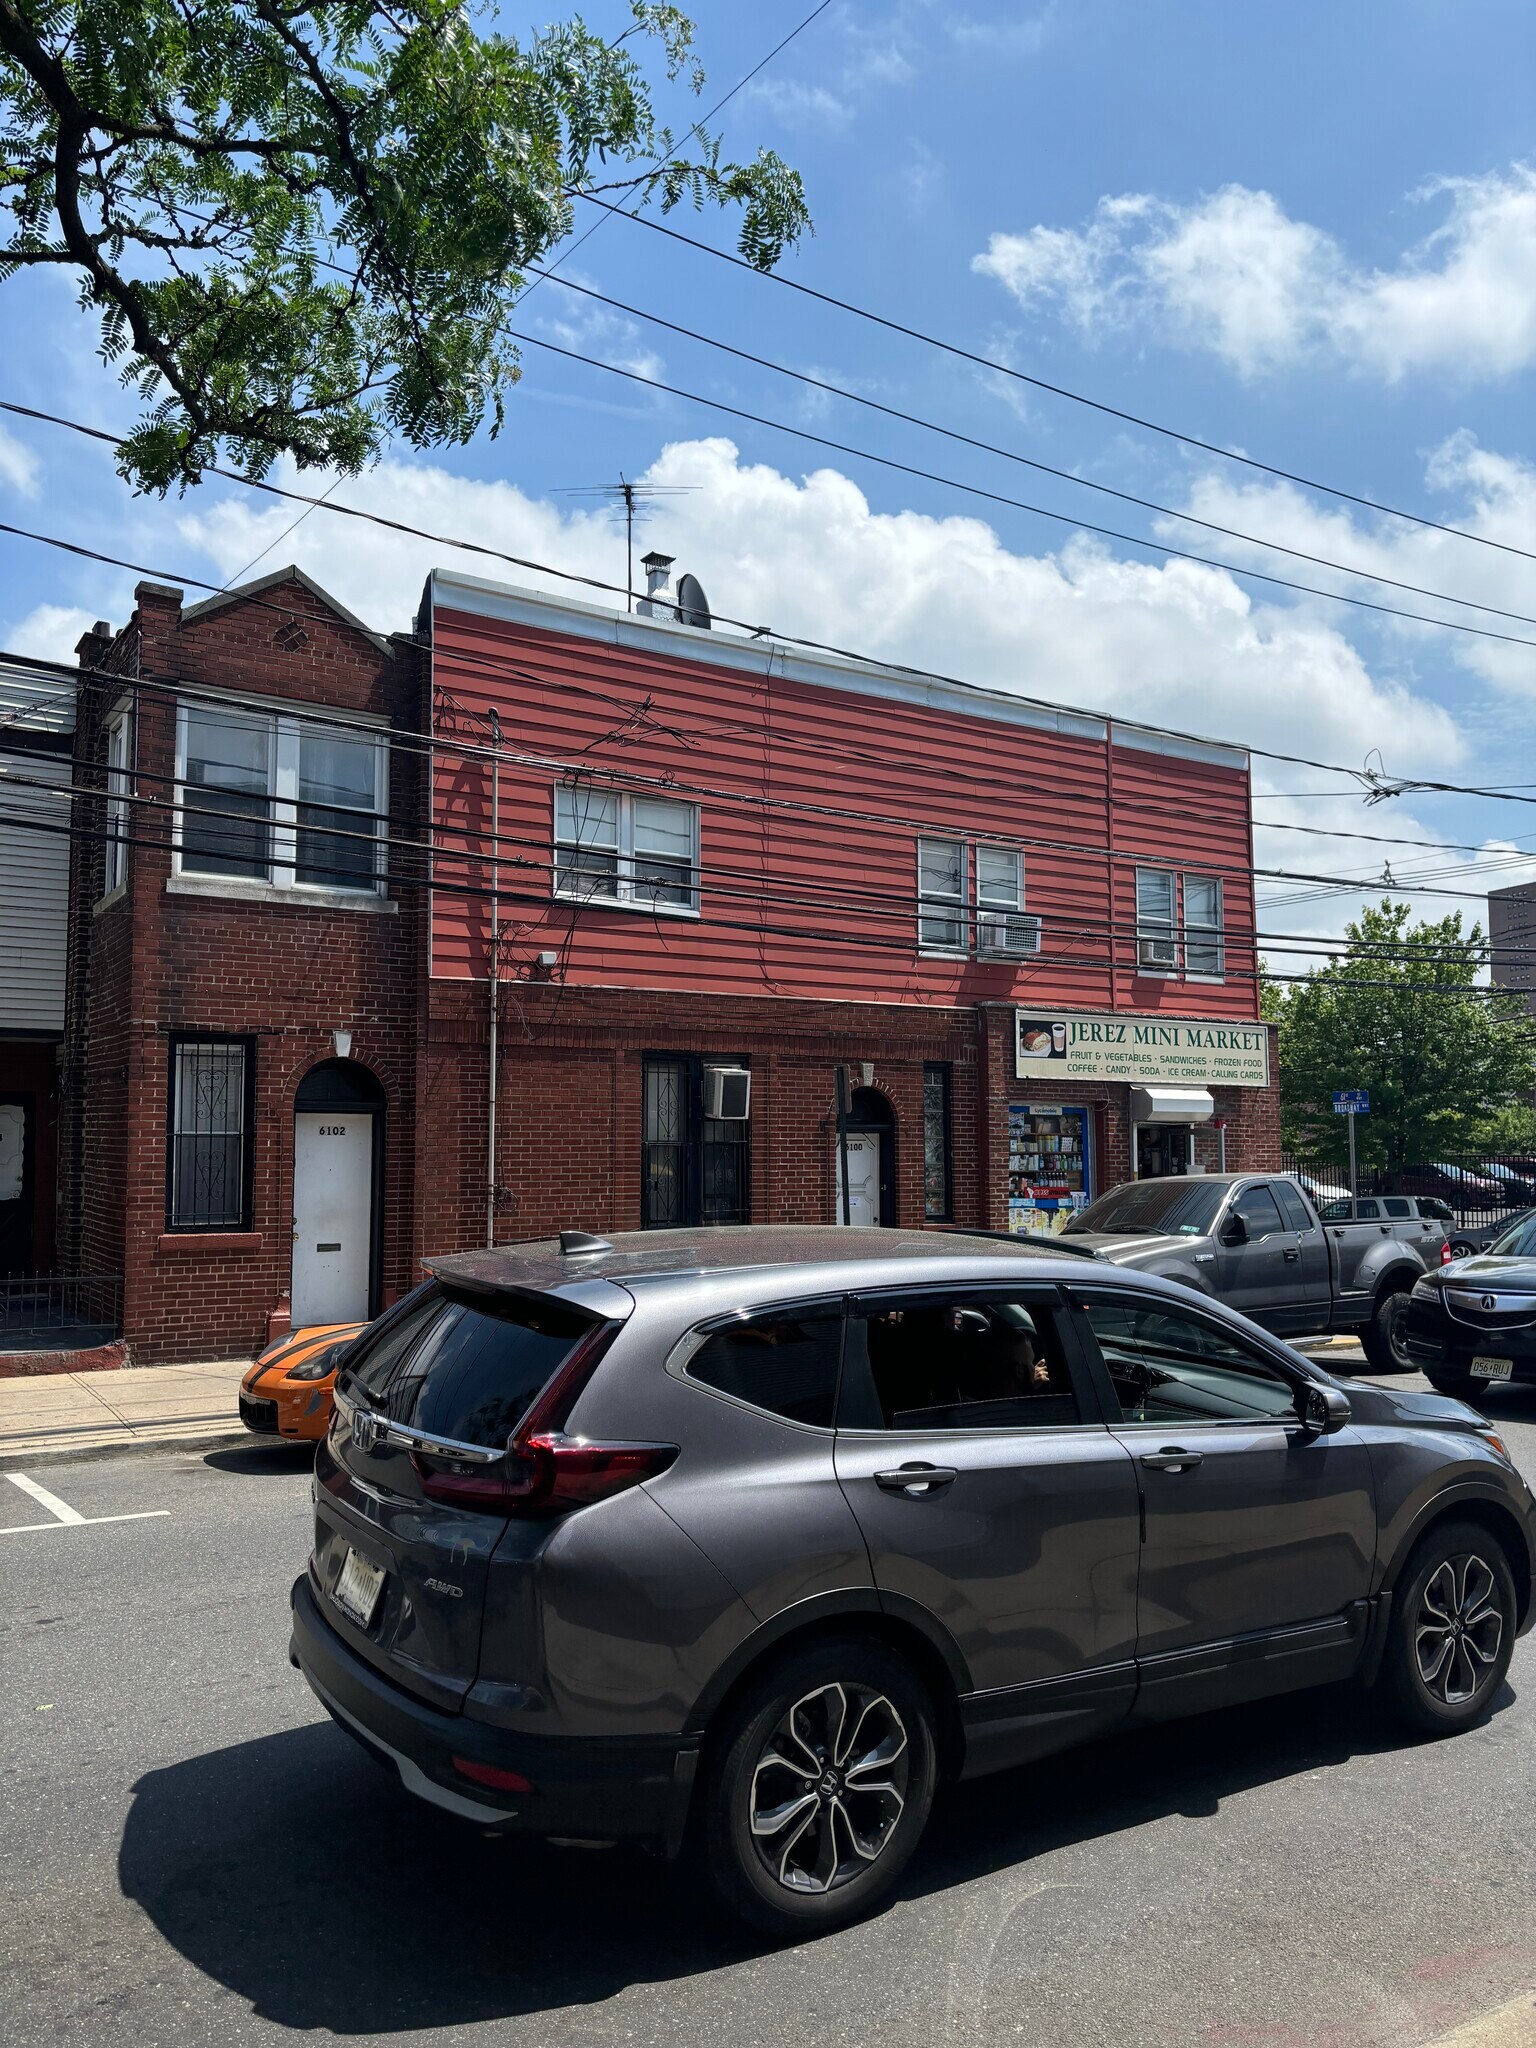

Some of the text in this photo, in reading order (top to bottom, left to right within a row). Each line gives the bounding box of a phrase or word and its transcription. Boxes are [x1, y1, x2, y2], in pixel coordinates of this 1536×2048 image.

[1069, 1021, 1263, 1051] JEREZ MINI MARKET
[1070, 1051, 1263, 1068] FRUIT & VEGETABLES SANDWICHES FROZEN FOOD
[1067, 1063, 1264, 1080] COFFEE CANDY SODA ICE CREAM CALLING CARDS
[1334, 1103, 1360, 1112] BROADWAY
[319, 1126, 346, 1136] 6102
[423, 1577, 464, 1598] AWD
